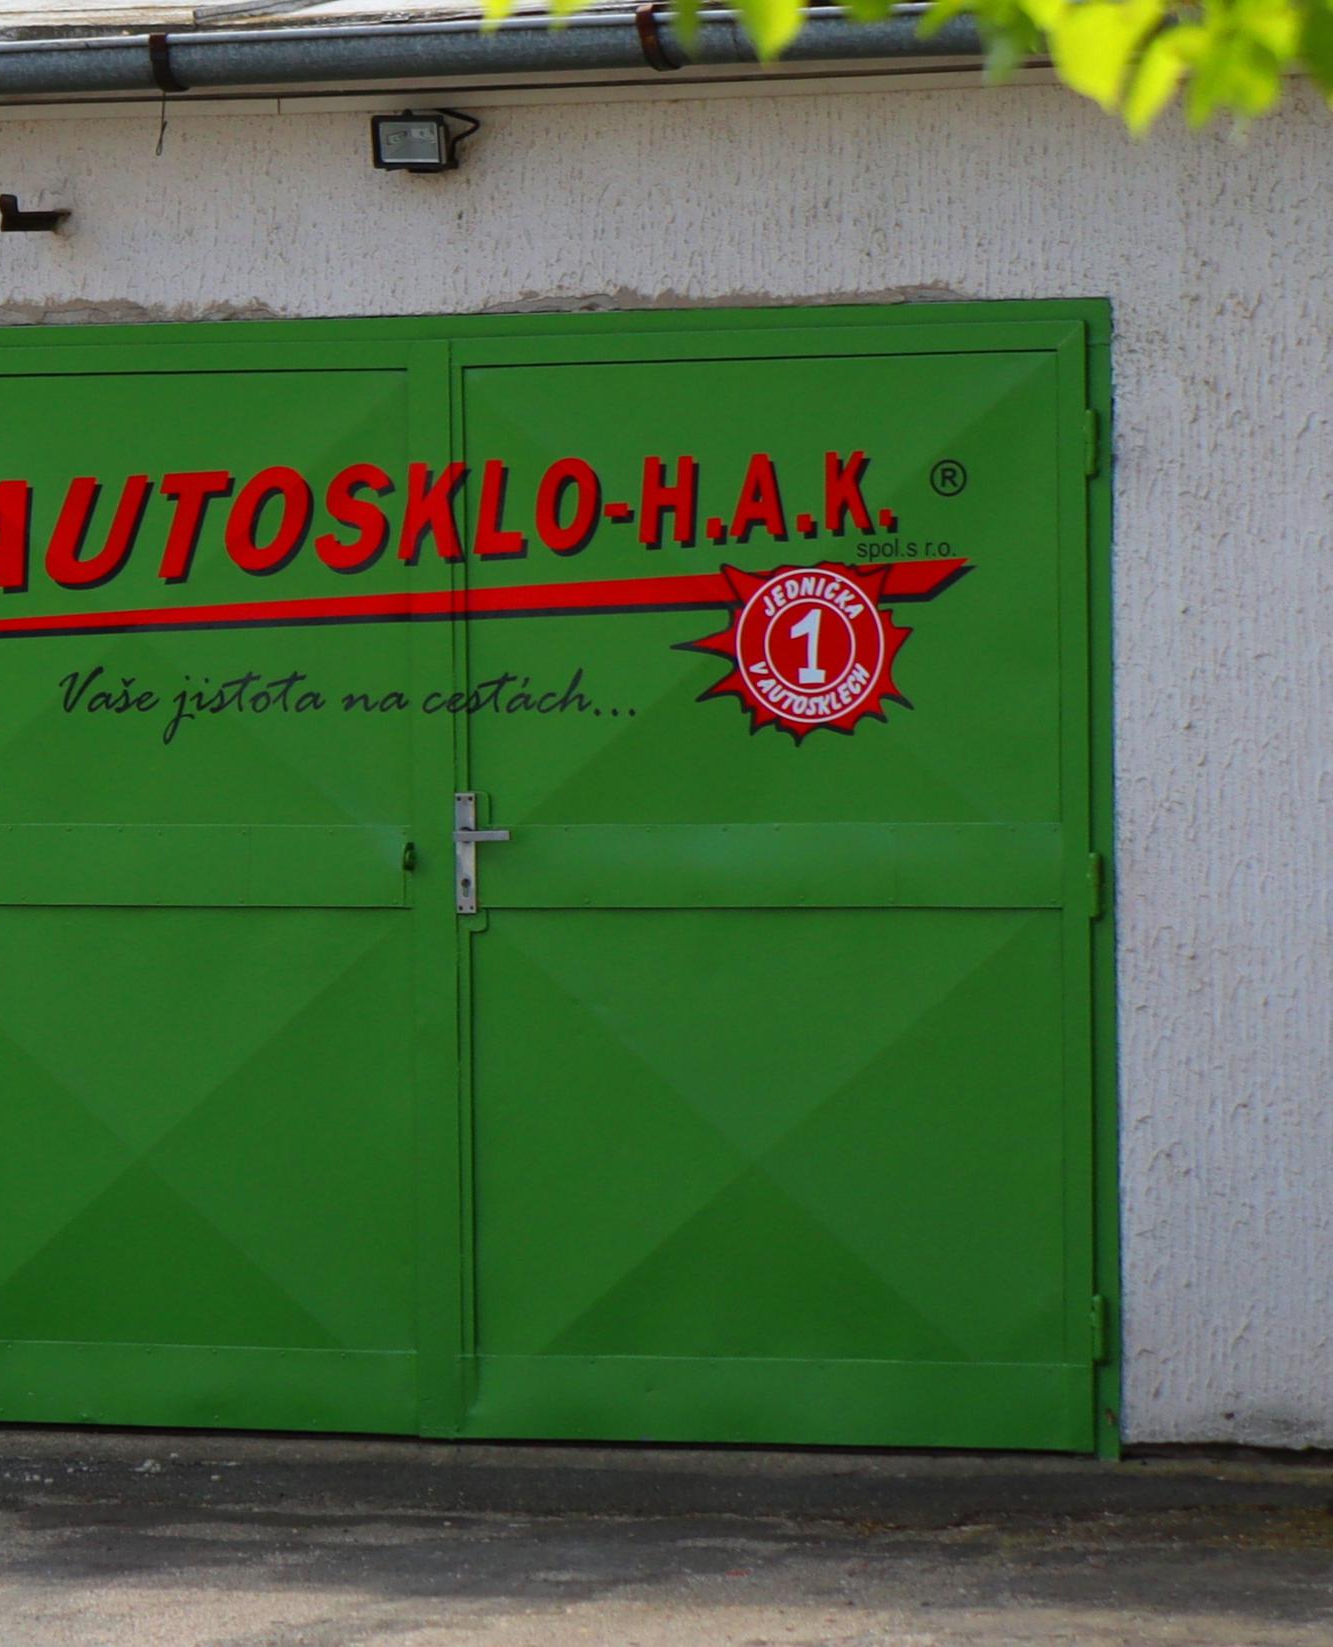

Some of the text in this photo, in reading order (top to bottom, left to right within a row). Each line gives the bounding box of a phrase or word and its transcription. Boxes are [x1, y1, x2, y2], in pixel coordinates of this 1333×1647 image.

[762, 576, 865, 620] JEDNIČKA
[790, 608, 826, 684] 1
[59, 665, 637, 746] Vaše jistota na cestách...
[749, 661, 870, 716] V AUTOSKLECH
